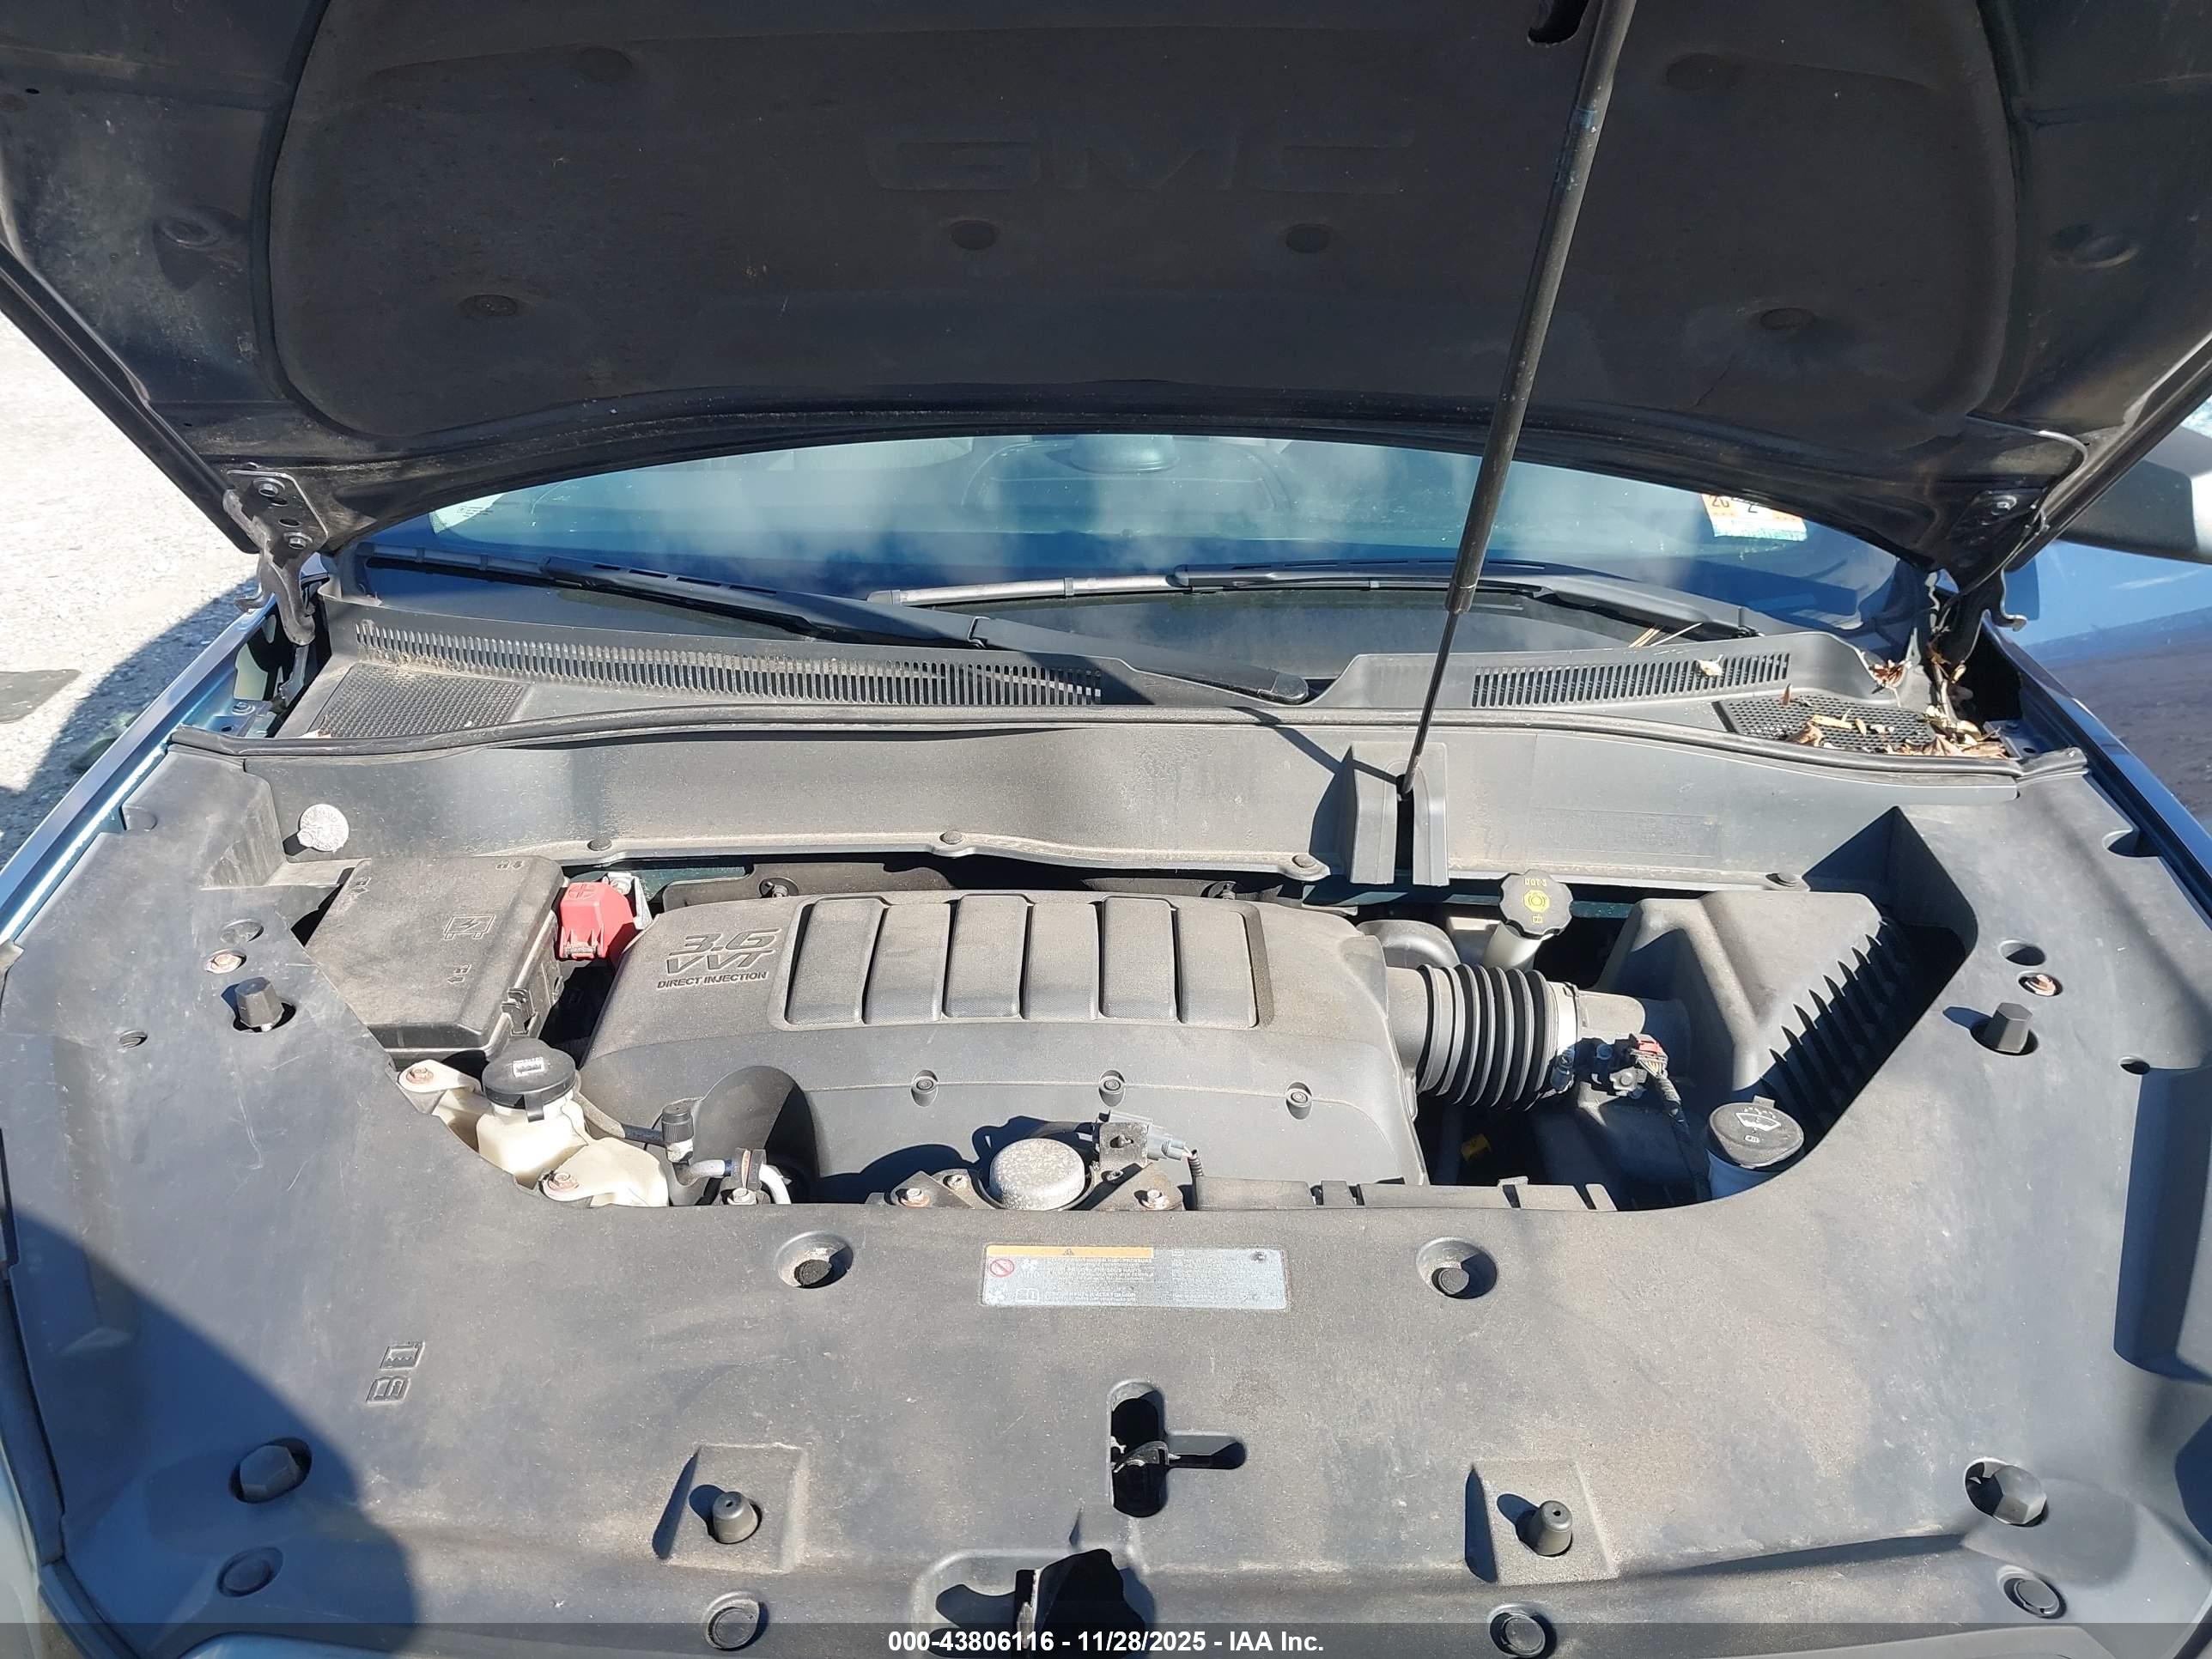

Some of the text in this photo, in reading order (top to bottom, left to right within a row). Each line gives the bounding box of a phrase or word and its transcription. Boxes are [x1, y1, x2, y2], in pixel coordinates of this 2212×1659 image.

[863, 125, 1415, 194] GMC
[668, 927, 781, 957] 3.6
[666, 949, 775, 975] VVT
[657, 971, 768, 989] DIRECT INJECTION
